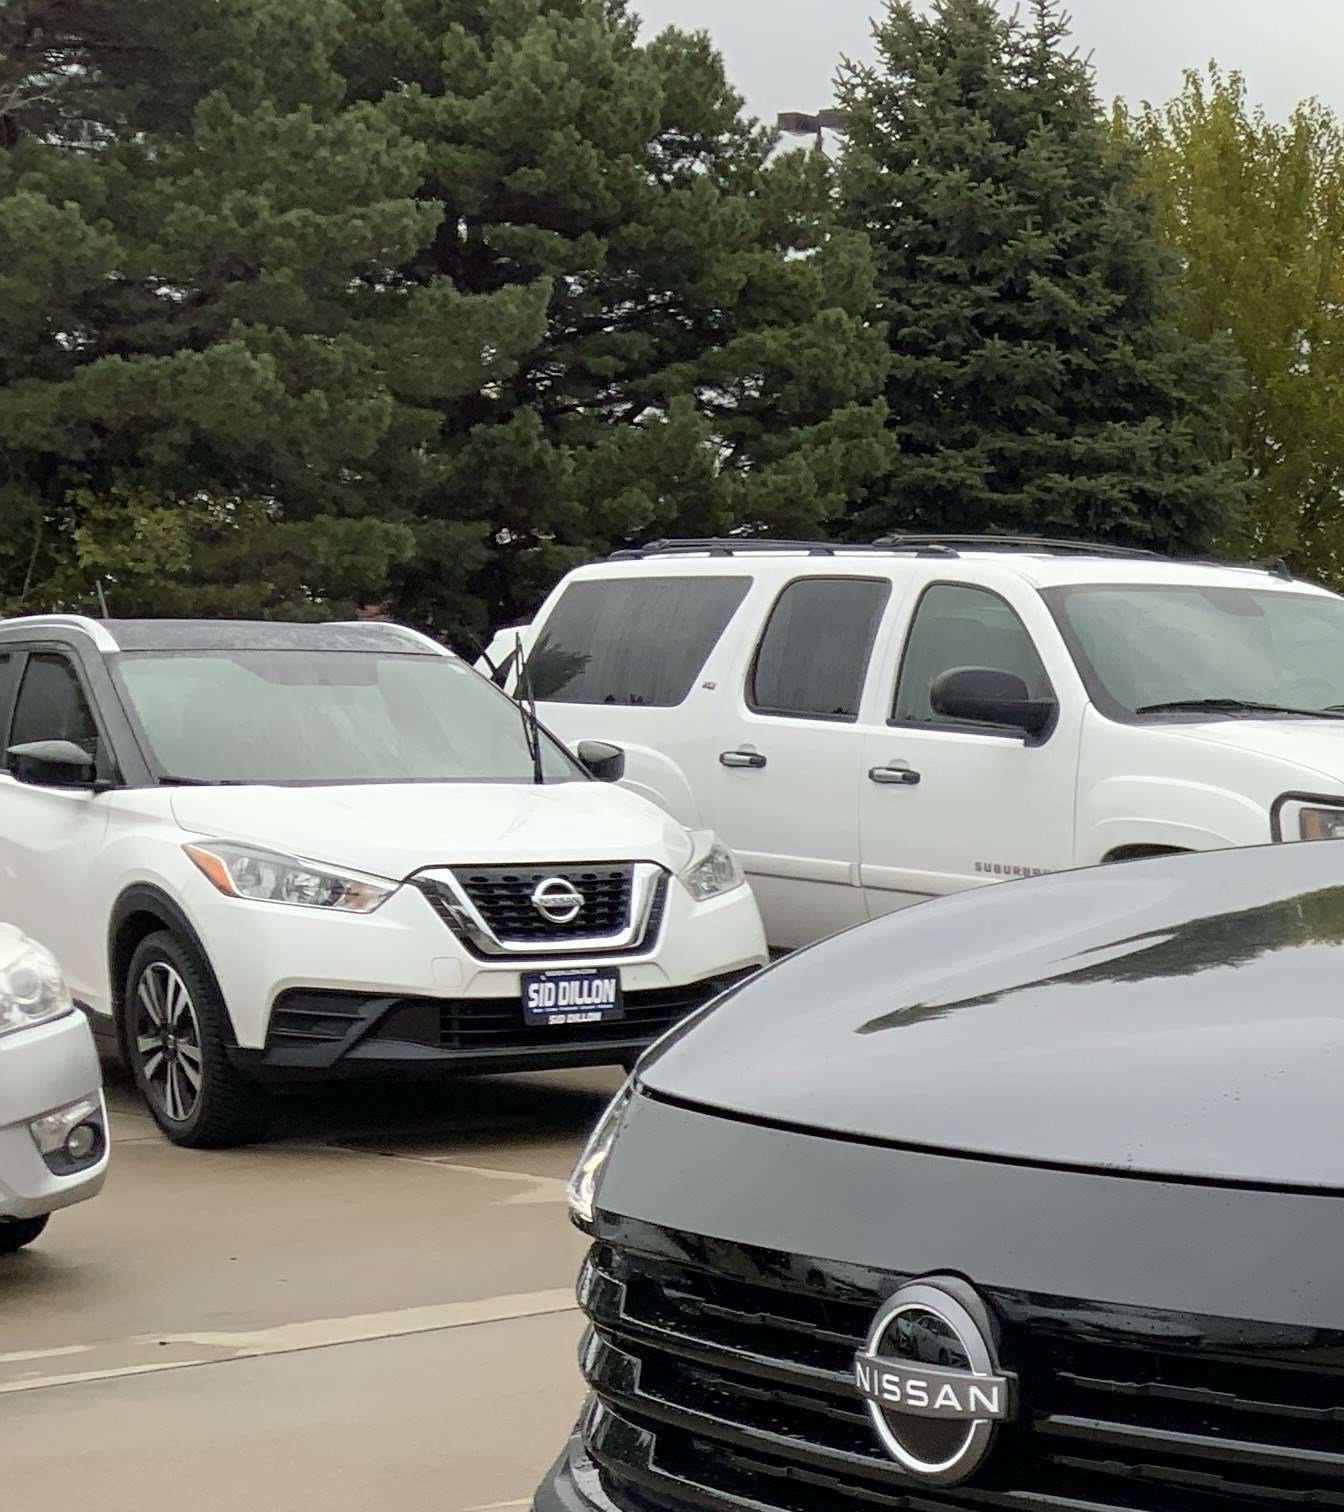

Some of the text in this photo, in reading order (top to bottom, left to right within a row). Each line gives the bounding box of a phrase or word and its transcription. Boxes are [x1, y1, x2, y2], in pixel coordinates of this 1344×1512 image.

[528, 978, 617, 1008] SID DILLON
[855, 1360, 1000, 1413] NISSAN
